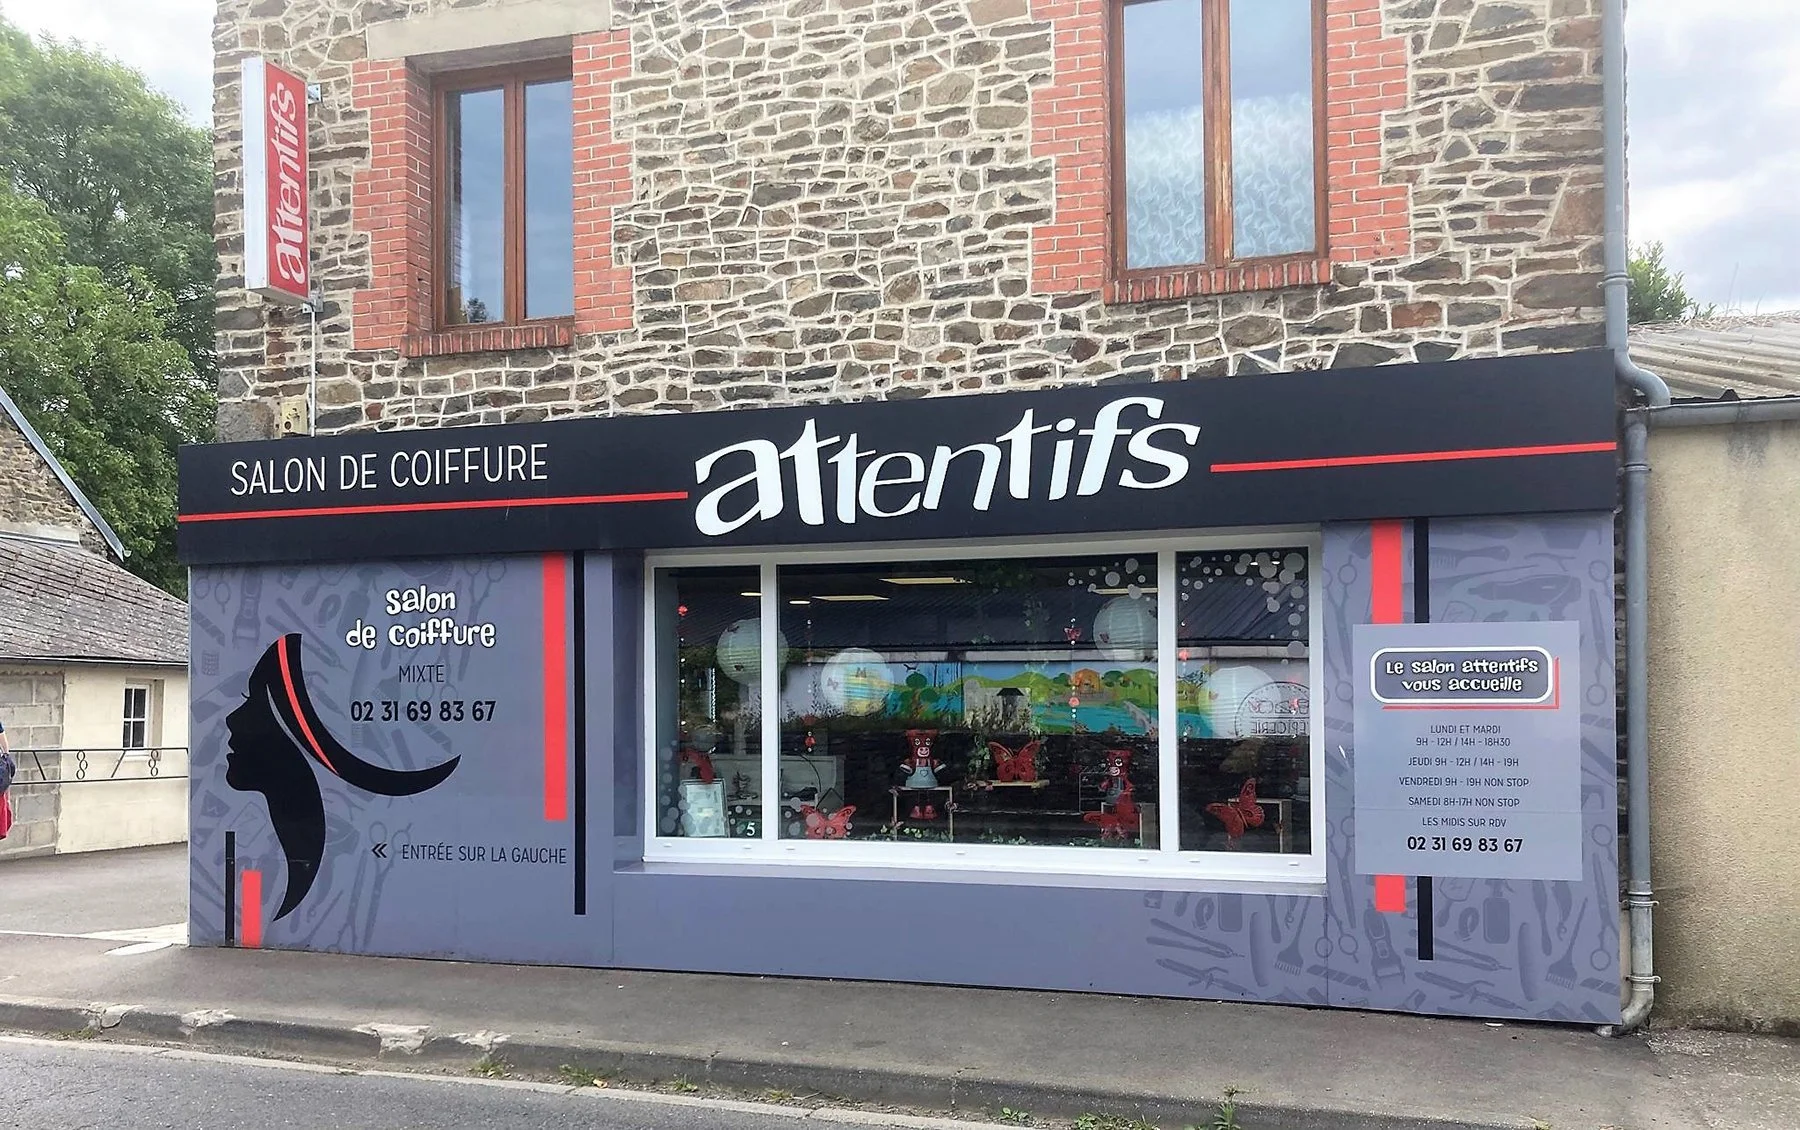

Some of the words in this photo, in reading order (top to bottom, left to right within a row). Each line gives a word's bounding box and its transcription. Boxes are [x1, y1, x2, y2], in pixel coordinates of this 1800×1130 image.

[269, 81, 306, 285] attentifs
[230, 456, 326, 496] SALON
[340, 452, 378, 491] DE
[390, 443, 548, 488] COIFFURE
[695, 396, 1201, 537] attentifs
[385, 584, 456, 615] salon
[345, 618, 376, 649] de
[388, 617, 496, 648] coiffure
[399, 665, 445, 682] MIXTE
[1411, 659, 1455, 674] salon
[1461, 657, 1538, 673] attentifs
[1402, 678, 1441, 692] vous
[1448, 676, 1522, 691] accueille
[351, 701, 373, 722] 02
[381, 701, 399, 722] 31
[406, 701, 431, 722] 69
[439, 701, 464, 722] 83
[472, 700, 496, 722] 67
[1430, 725, 1457, 734] LUNDI
[1460, 725, 1469, 734] ET
[1473, 725, 1501, 734] MARDI
[1416, 737, 1428, 746] 9H
[1437, 737, 1452, 746] 12H
[1461, 737, 1475, 746] 14H
[1485, 737, 1511, 747] 18H30
[1408, 756, 1433, 766] JEUDI
[1435, 757, 1447, 766] 9H
[1456, 757, 1471, 767] 12H
[1480, 757, 1495, 767] 14H
[1504, 757, 1519, 767] 19H
[1399, 776, 1443, 786] VENDREDI
[1445, 777, 1458, 787] 9H
[1466, 777, 1482, 787] 19H
[1484, 777, 1504, 787] NON
[1506, 777, 1530, 788] STOP
[1408, 796, 1441, 807] SAMEDI
[1443, 797, 1472, 807] 8H-17H
[1475, 797, 1495, 807] NON
[1497, 798, 1520, 808] STOP
[746, 821, 756, 837] 5
[1422, 817, 1438, 826] LES
[1441, 817, 1465, 827] MIDIS
[1467, 818, 1486, 828] SUR
[1488, 818, 1507, 829] RDV
[402, 842, 453, 861] ENTRÉE
[458, 846, 486, 862] SUR
[491, 847, 507, 863] LA
[511, 847, 567, 864] GAUCHE
[1407, 836, 1426, 851] 02
[1431, 836, 1446, 851] 31
[1452, 837, 1472, 852] 69
[1478, 837, 1498, 853] 83
[1503, 838, 1523, 853] 67
